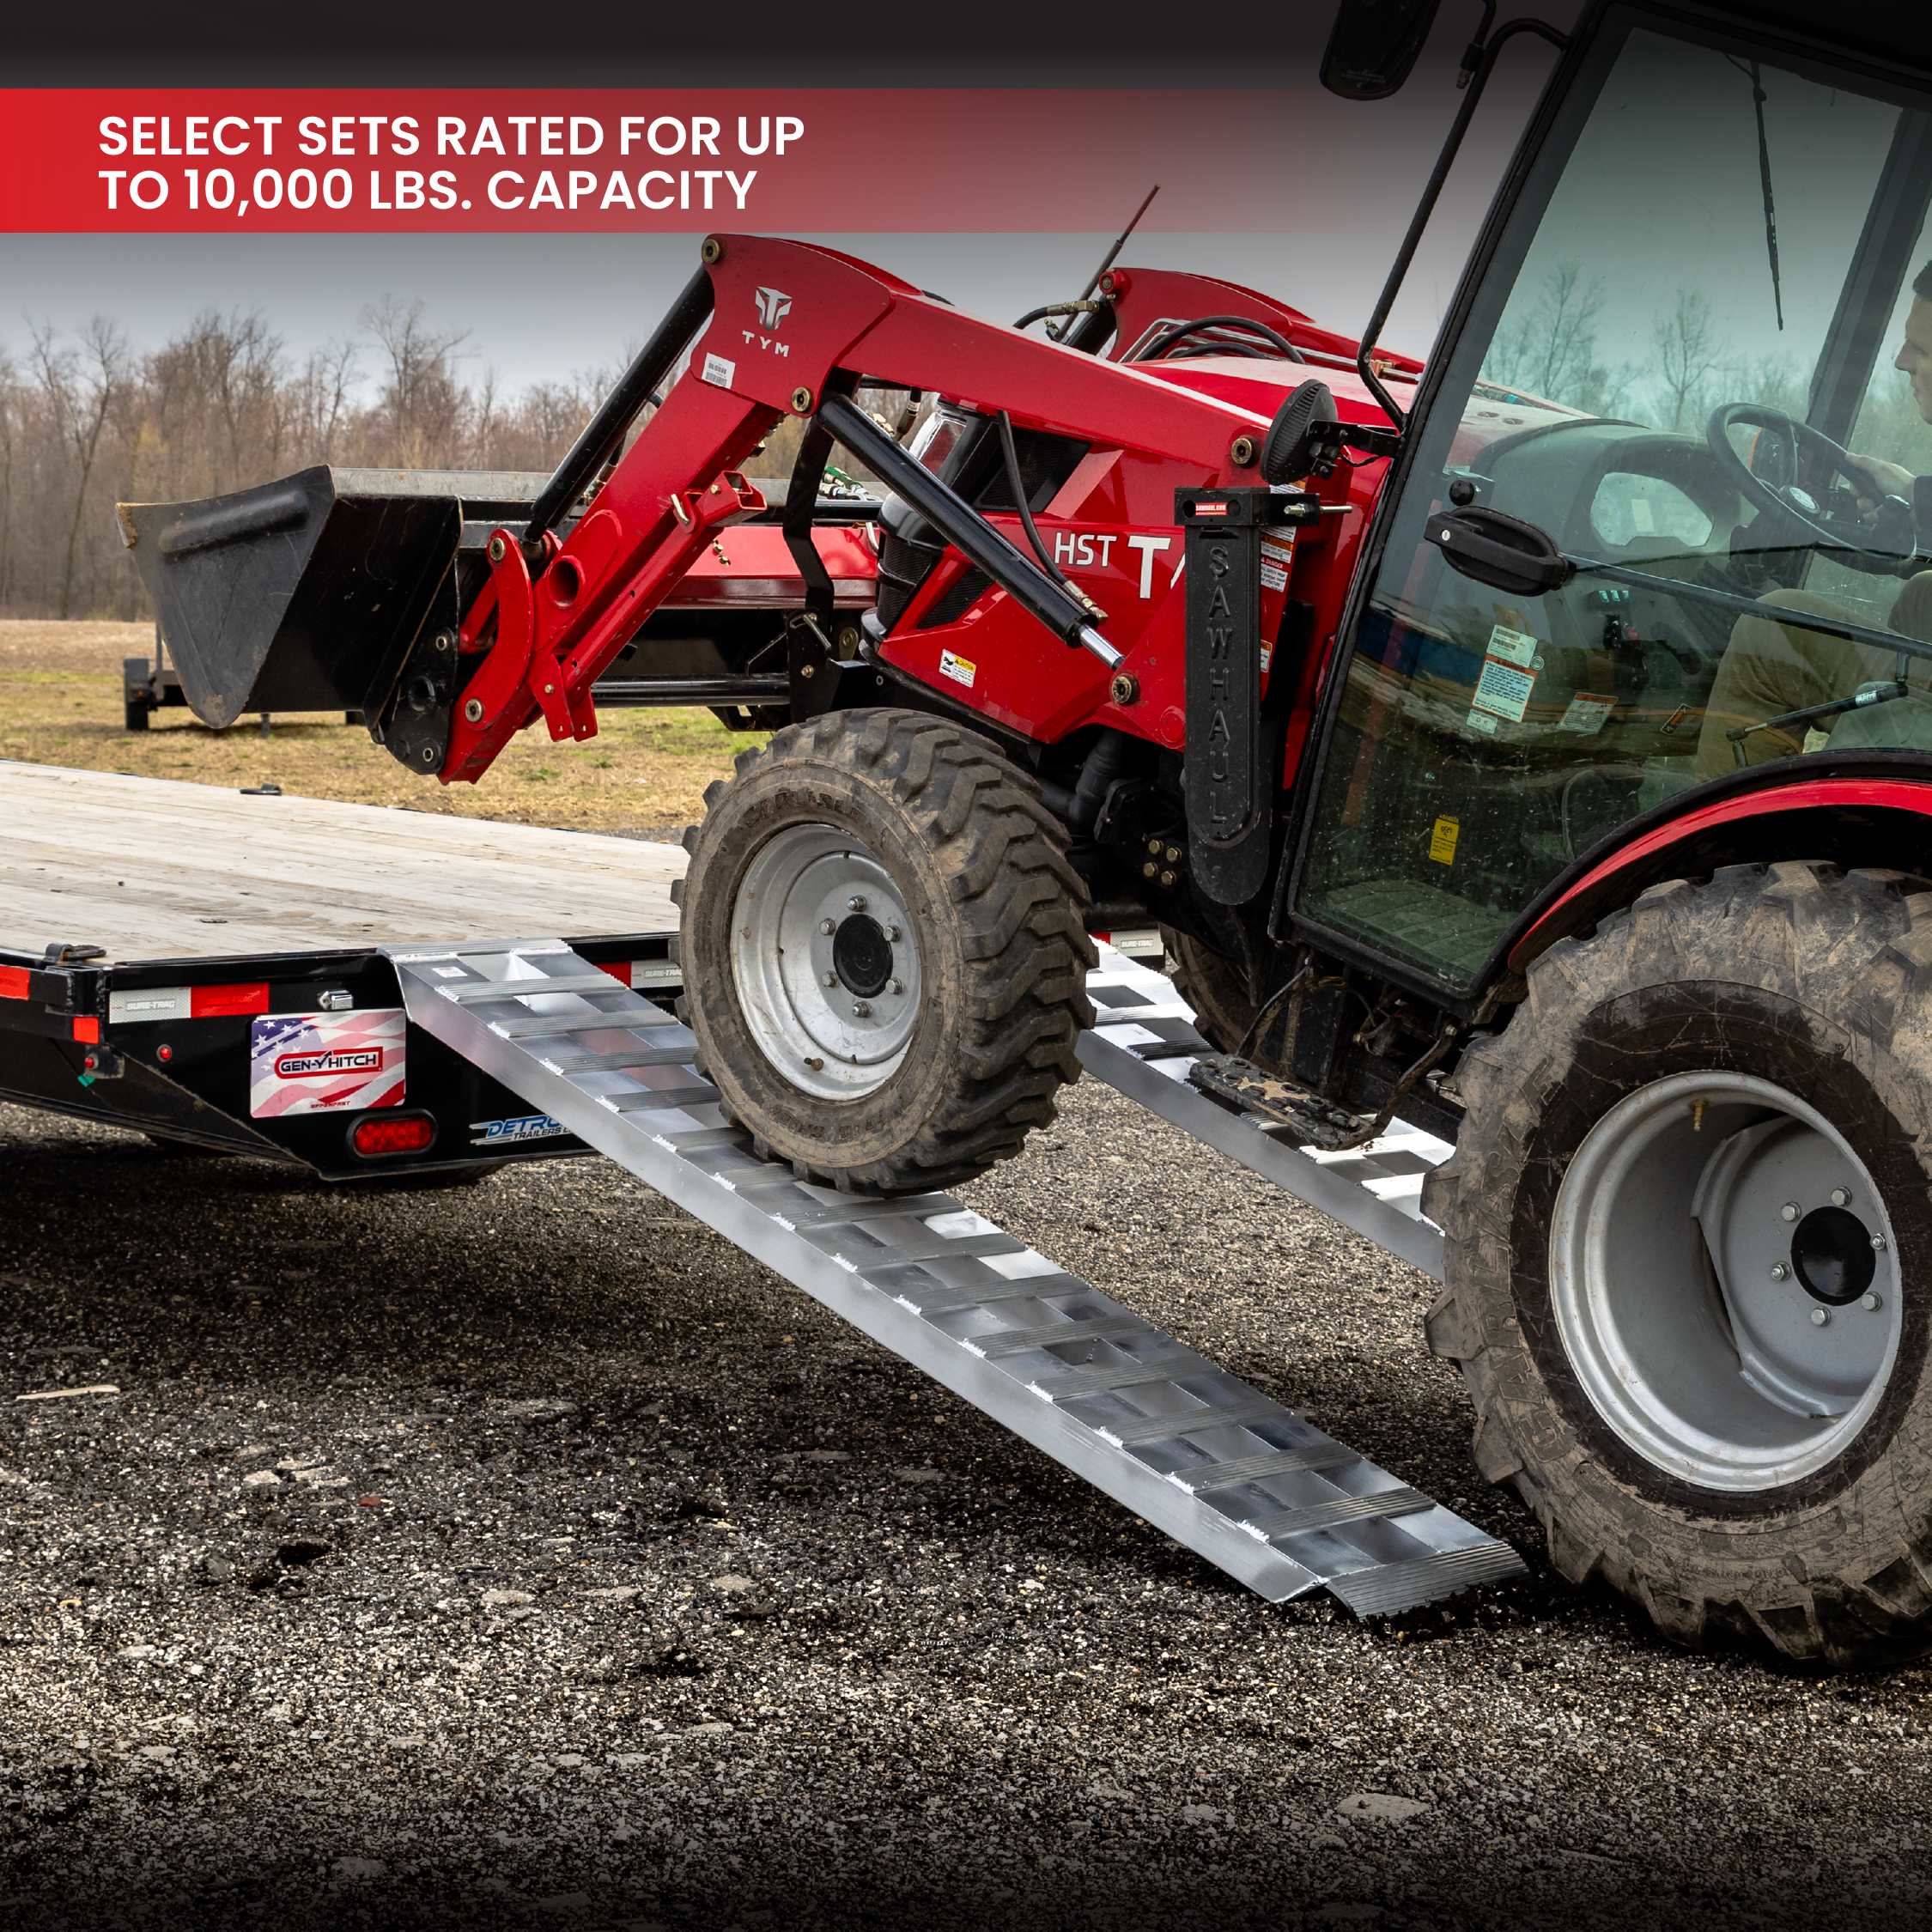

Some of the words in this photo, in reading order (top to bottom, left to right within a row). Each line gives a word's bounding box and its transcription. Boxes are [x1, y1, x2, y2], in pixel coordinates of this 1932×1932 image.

[742, 330, 790, 358] TYM
[1054, 532, 1117, 568] HST
[1127, 534, 1185, 599] T
[1206, 544, 1234, 825] SAWHAUL
[126, 999, 176, 1011] SURE-TRAC
[280, 1050, 333, 1072] GEN-Y
[328, 1054, 376, 1068] HITCH
[513, 1127, 562, 1139] TRAILERS
